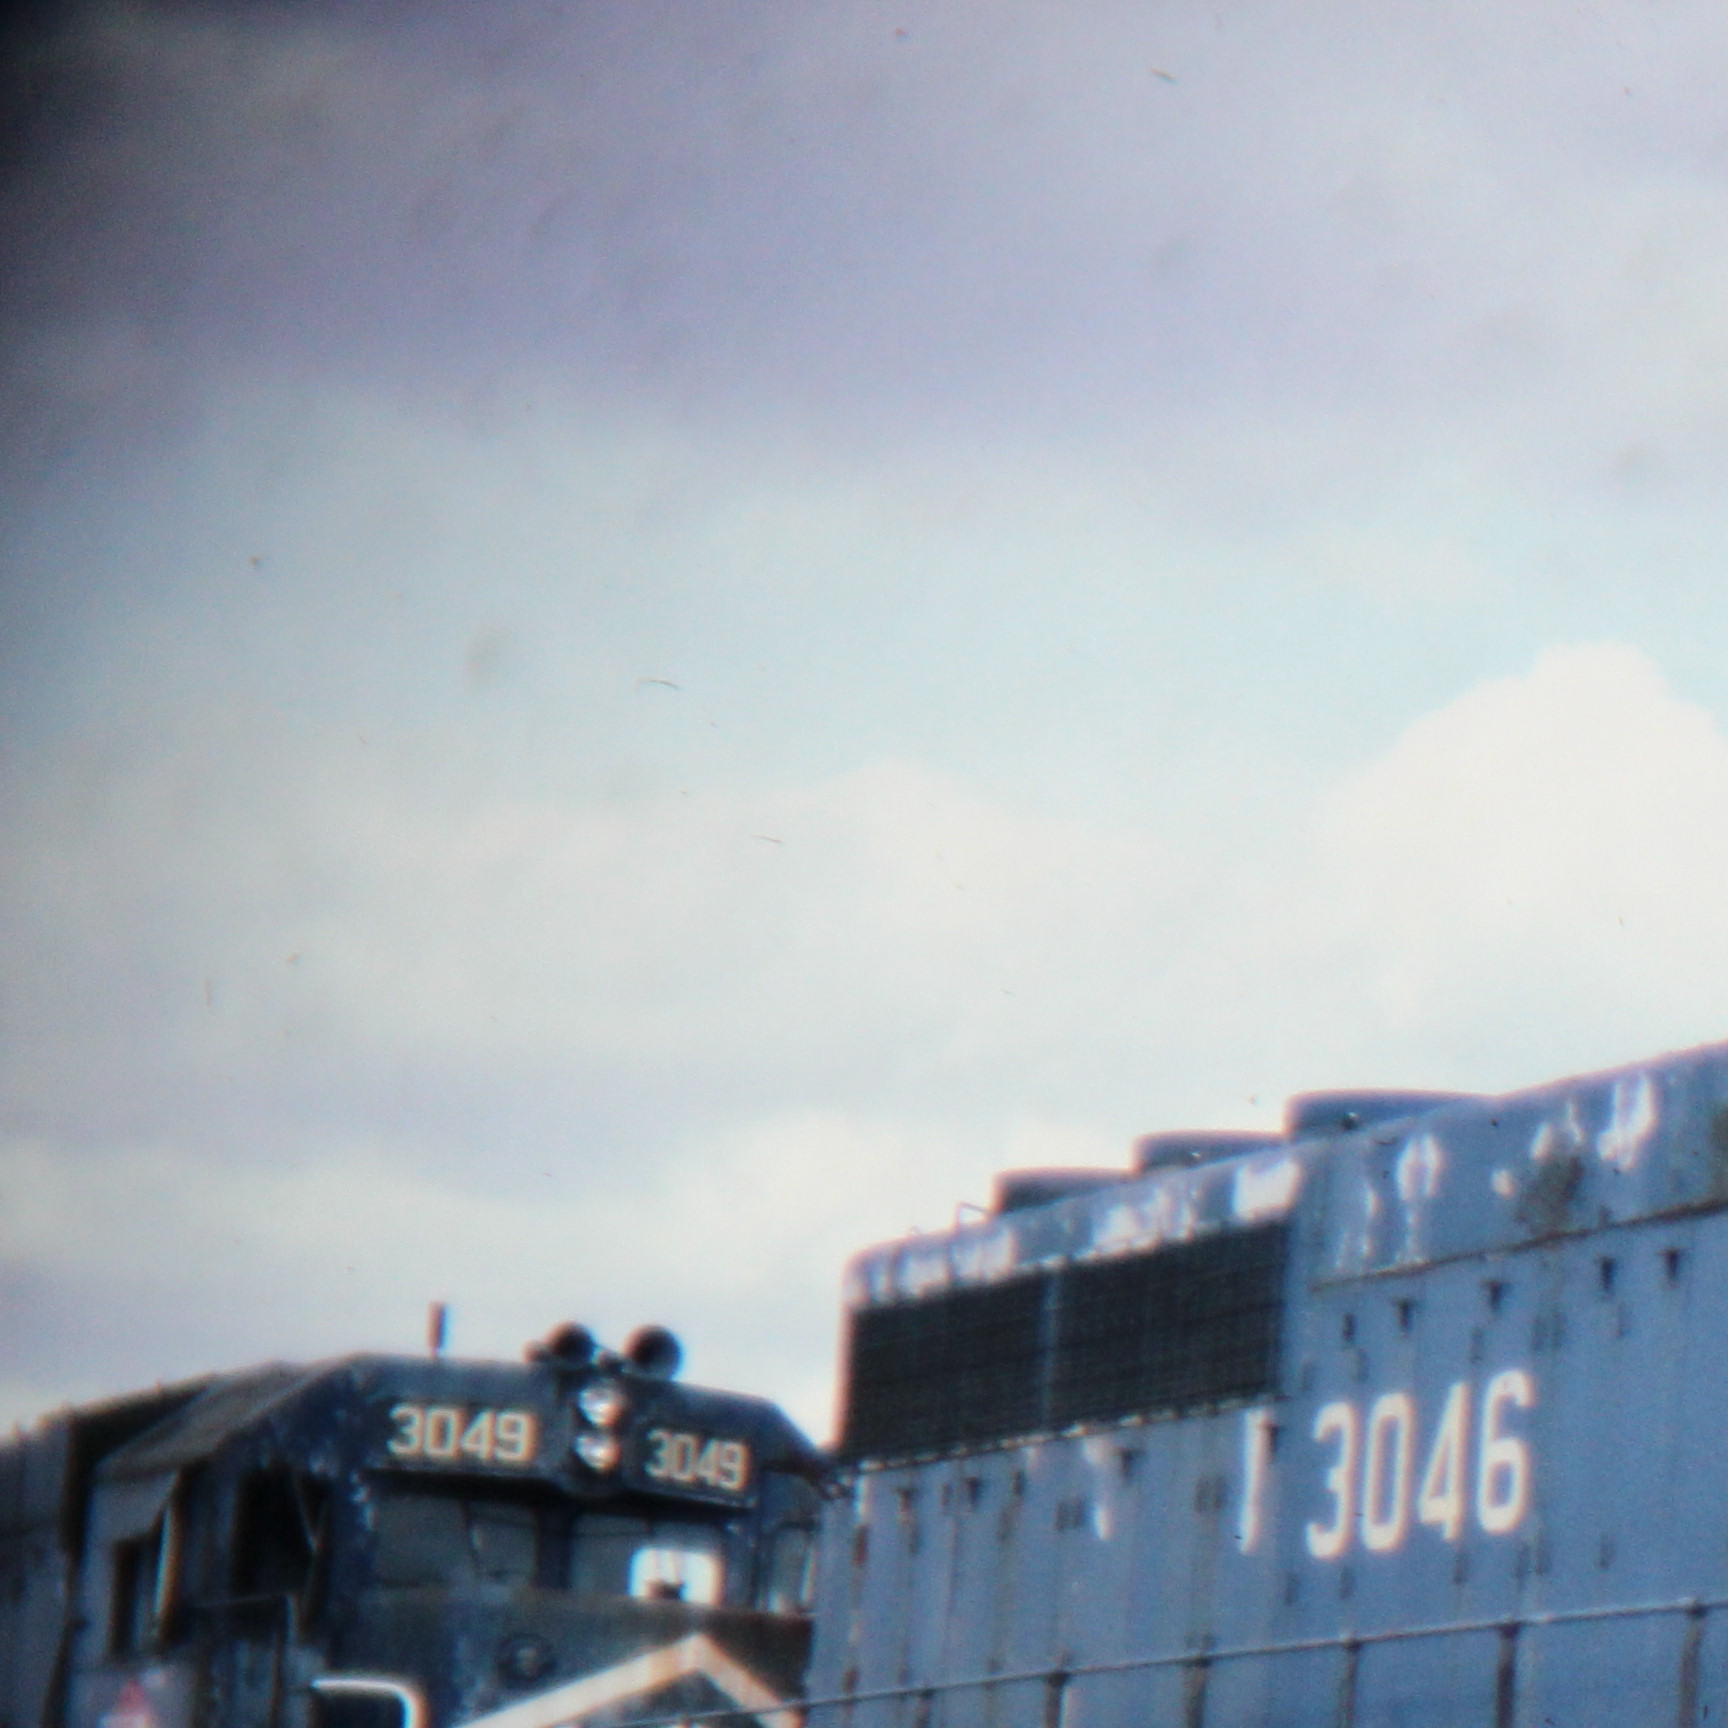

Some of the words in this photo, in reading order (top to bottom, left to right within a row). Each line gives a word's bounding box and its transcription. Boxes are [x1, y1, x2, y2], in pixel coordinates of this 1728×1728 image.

[387, 1403, 537, 1463] 3049
[644, 1427, 751, 1492] 3049
[1305, 1367, 1538, 1561] 3046
